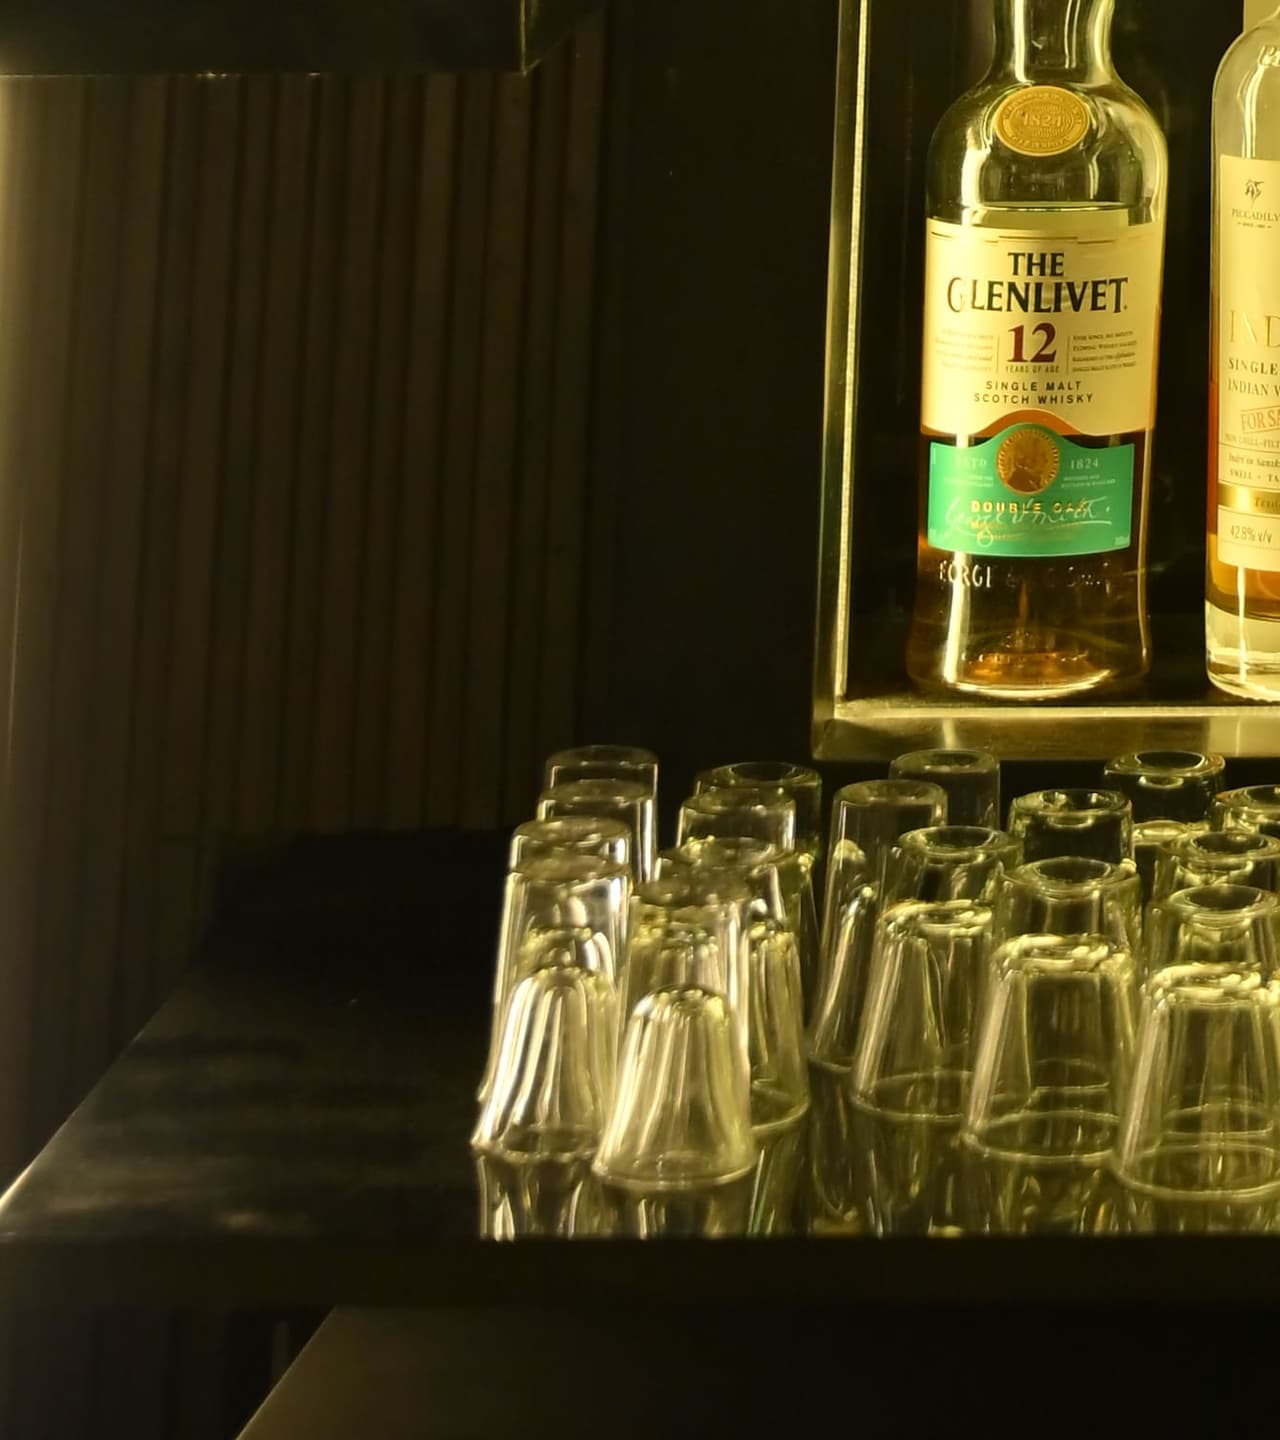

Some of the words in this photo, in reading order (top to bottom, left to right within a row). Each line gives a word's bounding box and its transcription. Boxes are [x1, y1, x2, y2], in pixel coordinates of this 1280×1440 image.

[1231, 207, 1280, 223] PICCADILY
[1007, 251, 1065, 278] THE
[946, 276, 1129, 314] GLENLIVET
[1006, 321, 1058, 364] 12
[1227, 356, 1278, 377] SINGLE
[984, 379, 1038, 392] SINGLE
[1044, 379, 1082, 391] MALT
[1228, 378, 1269, 398] INDIAN
[972, 392, 1030, 405] SCOTCH
[1036, 391, 1095, 405] WHISKY
[1240, 411, 1266, 432] FOR
[1069, 456, 1100, 470] 1824
[970, 499, 1042, 514] DOUBLE
